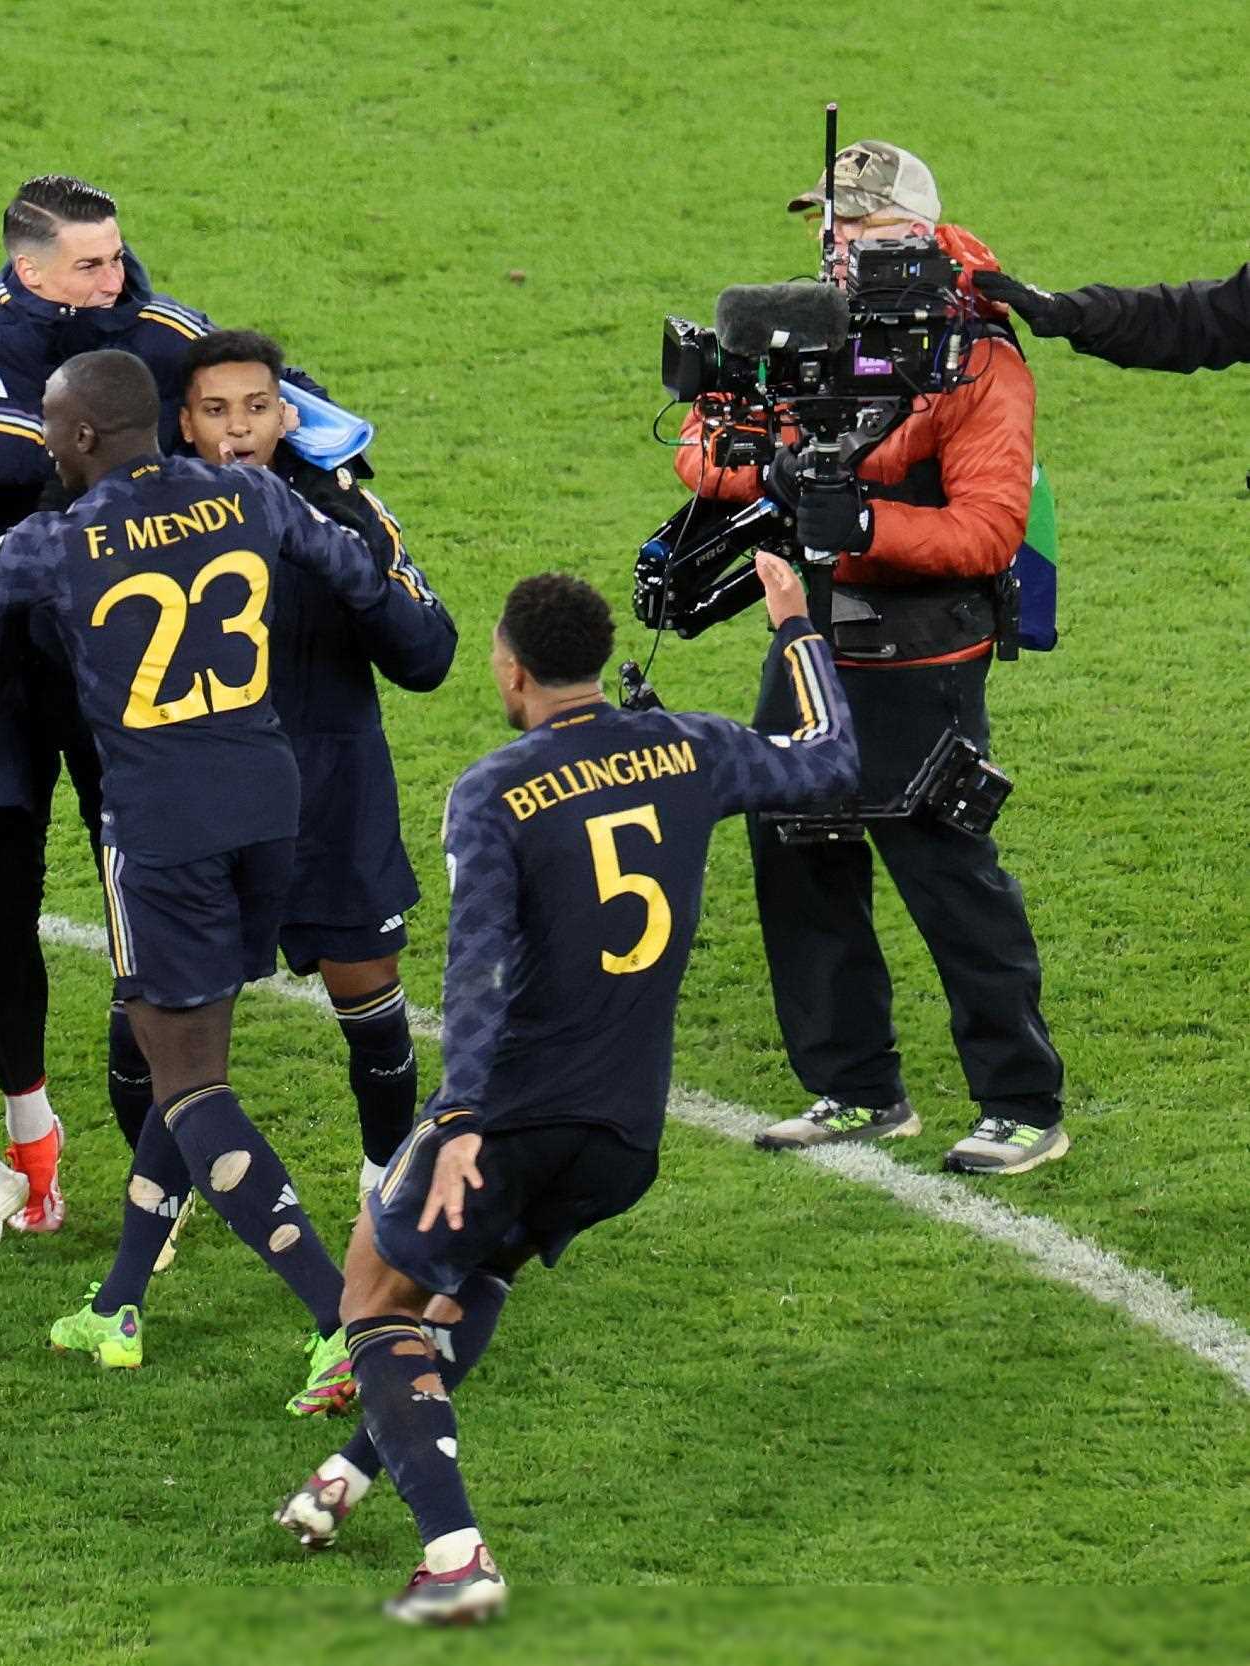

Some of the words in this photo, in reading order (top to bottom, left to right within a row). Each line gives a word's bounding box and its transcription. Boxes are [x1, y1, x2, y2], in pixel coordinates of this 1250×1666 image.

[84, 525, 114, 560] F.
[125, 493, 245, 551] MENDY
[91, 550, 270, 730] 23
[502, 740, 698, 822] BELLINGHAM
[584, 803, 673, 976] 5
